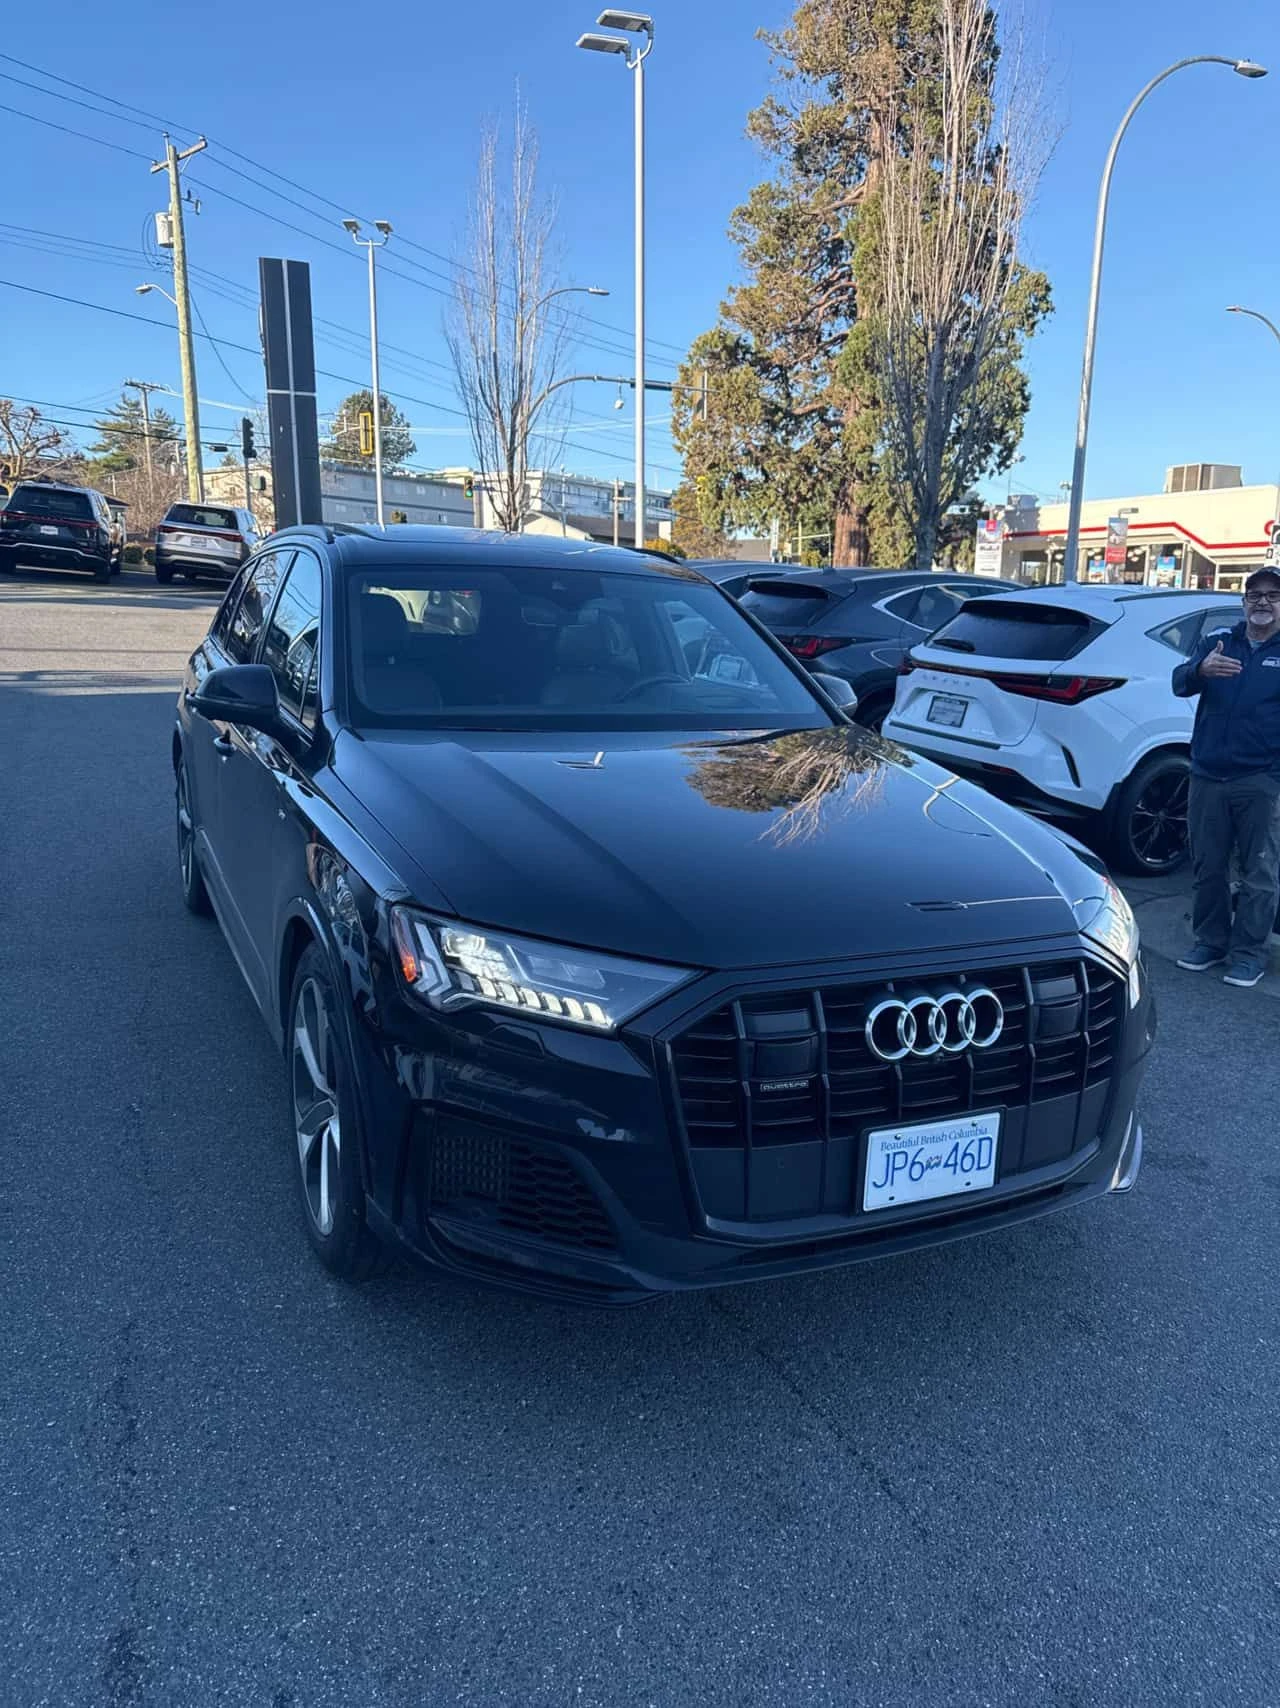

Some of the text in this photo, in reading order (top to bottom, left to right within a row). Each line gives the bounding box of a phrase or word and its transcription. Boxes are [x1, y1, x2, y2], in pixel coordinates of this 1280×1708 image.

[880, 1127, 988, 1151] Beautiful British Columbia
[872, 1136, 993, 1188] JP6 46D
